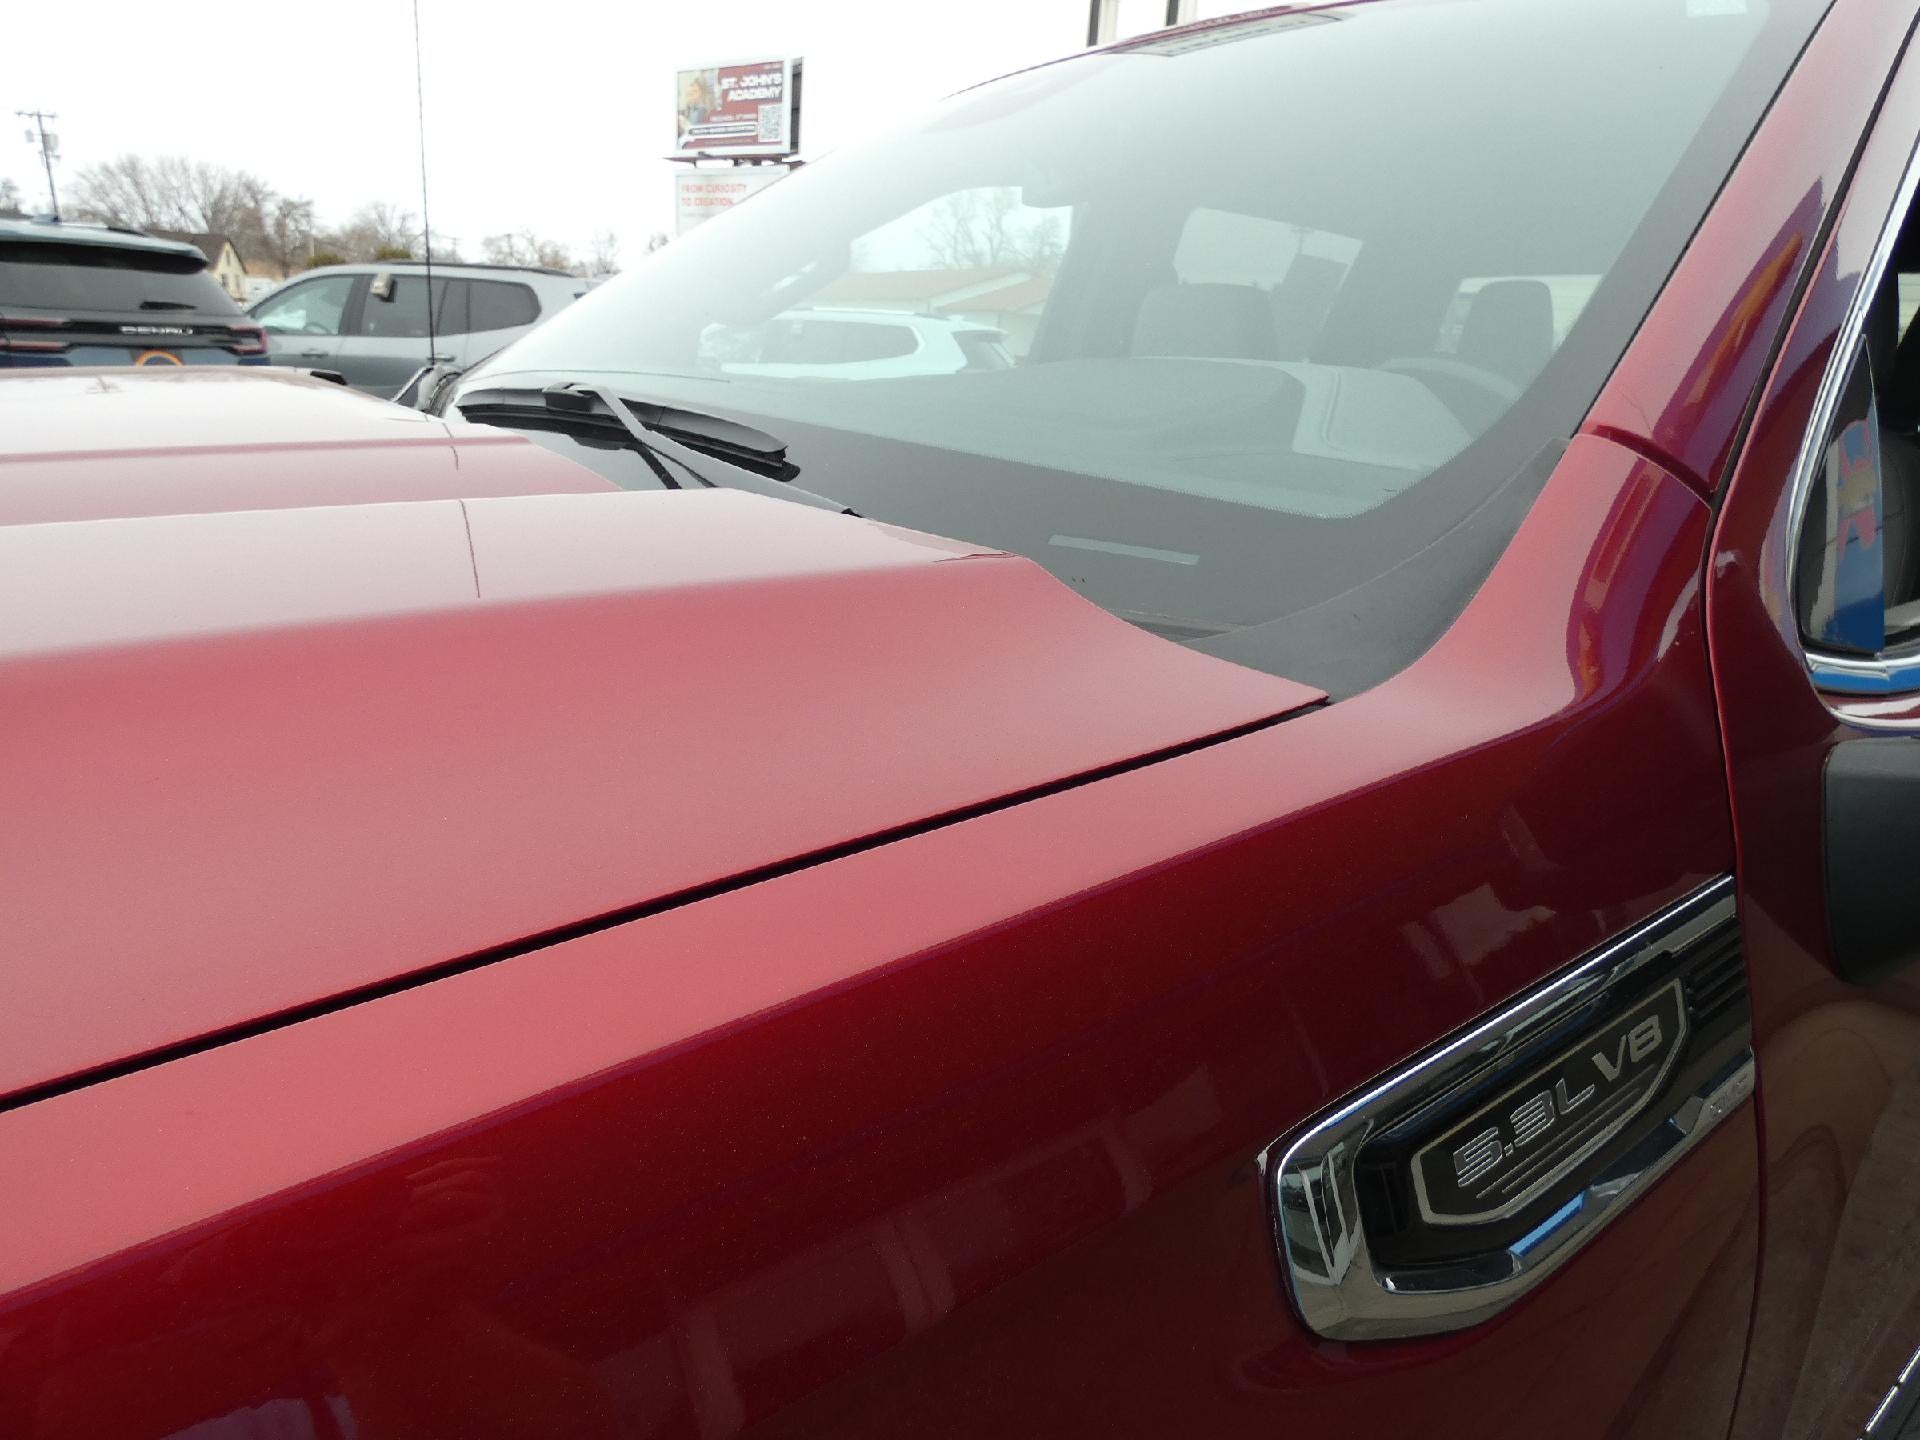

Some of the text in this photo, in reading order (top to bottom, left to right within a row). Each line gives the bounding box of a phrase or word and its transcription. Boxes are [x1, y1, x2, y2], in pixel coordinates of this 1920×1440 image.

[721, 73, 783, 90] ST. JOHN'S
[727, 87, 782, 102] ACADEMY
[681, 183, 746, 193] FROM CURIOSITY
[681, 197, 734, 207] TO CREATION
[121, 325, 193, 335] DENALI
[1453, 1014, 1663, 1188] 5.3L V8
